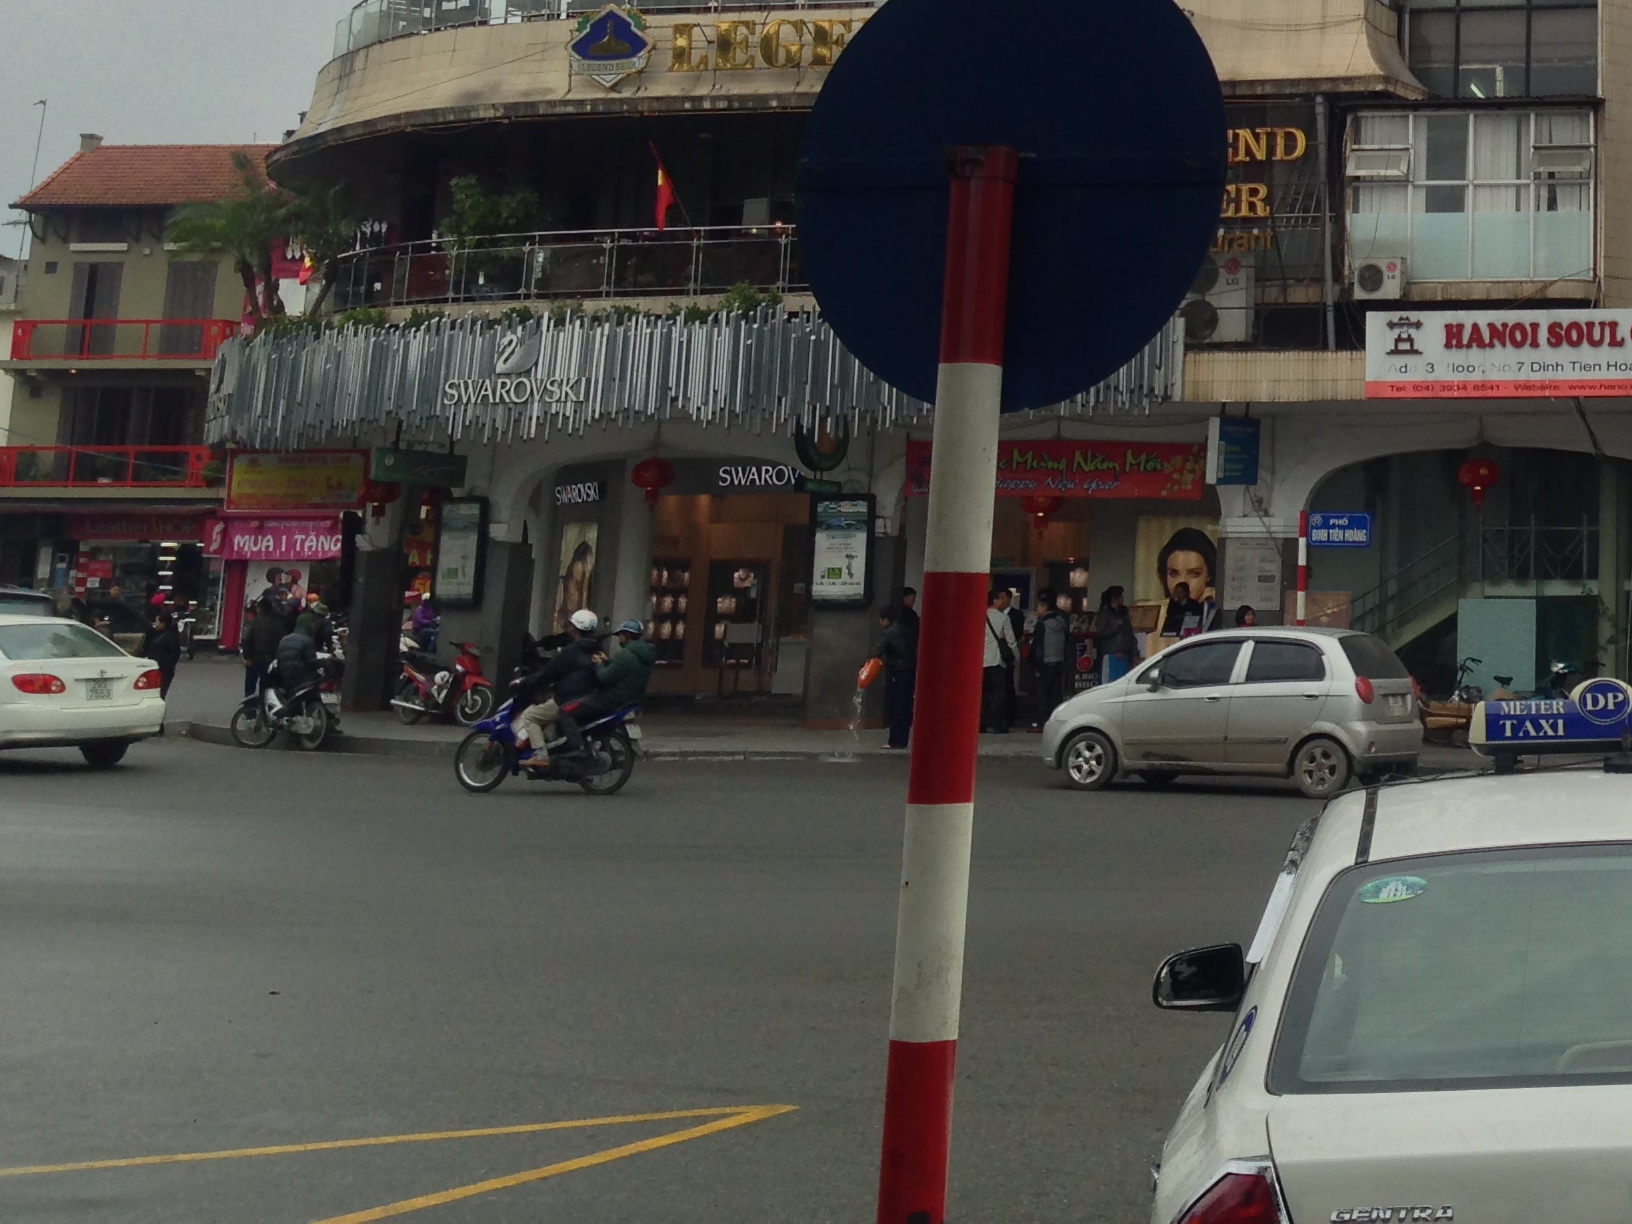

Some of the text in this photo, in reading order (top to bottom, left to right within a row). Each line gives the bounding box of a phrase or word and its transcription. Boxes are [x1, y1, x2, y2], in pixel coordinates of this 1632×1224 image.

[1226, 278, 1239, 286] LG
[1444, 323, 1540, 349] HANOI
[1547, 320, 1624, 348] SOUL
[1530, 360, 1564, 372] Dinh
[1569, 360, 1601, 372] Tien
[444, 377, 586, 405] SWAROVSKI
[719, 464, 806, 487] SWAROV
[555, 482, 600, 506] SWAROVSKI
[1329, 516, 1348, 525] PHỐ
[234, 535, 274, 552] MUA
[1345, 529, 1367, 542] HOÀNG
[1501, 701, 1564, 715] METER
[1586, 692, 1625, 711] DP
[1500, 719, 1564, 737] TAXI
[1330, 1204, 1454, 1223] GENTRA
